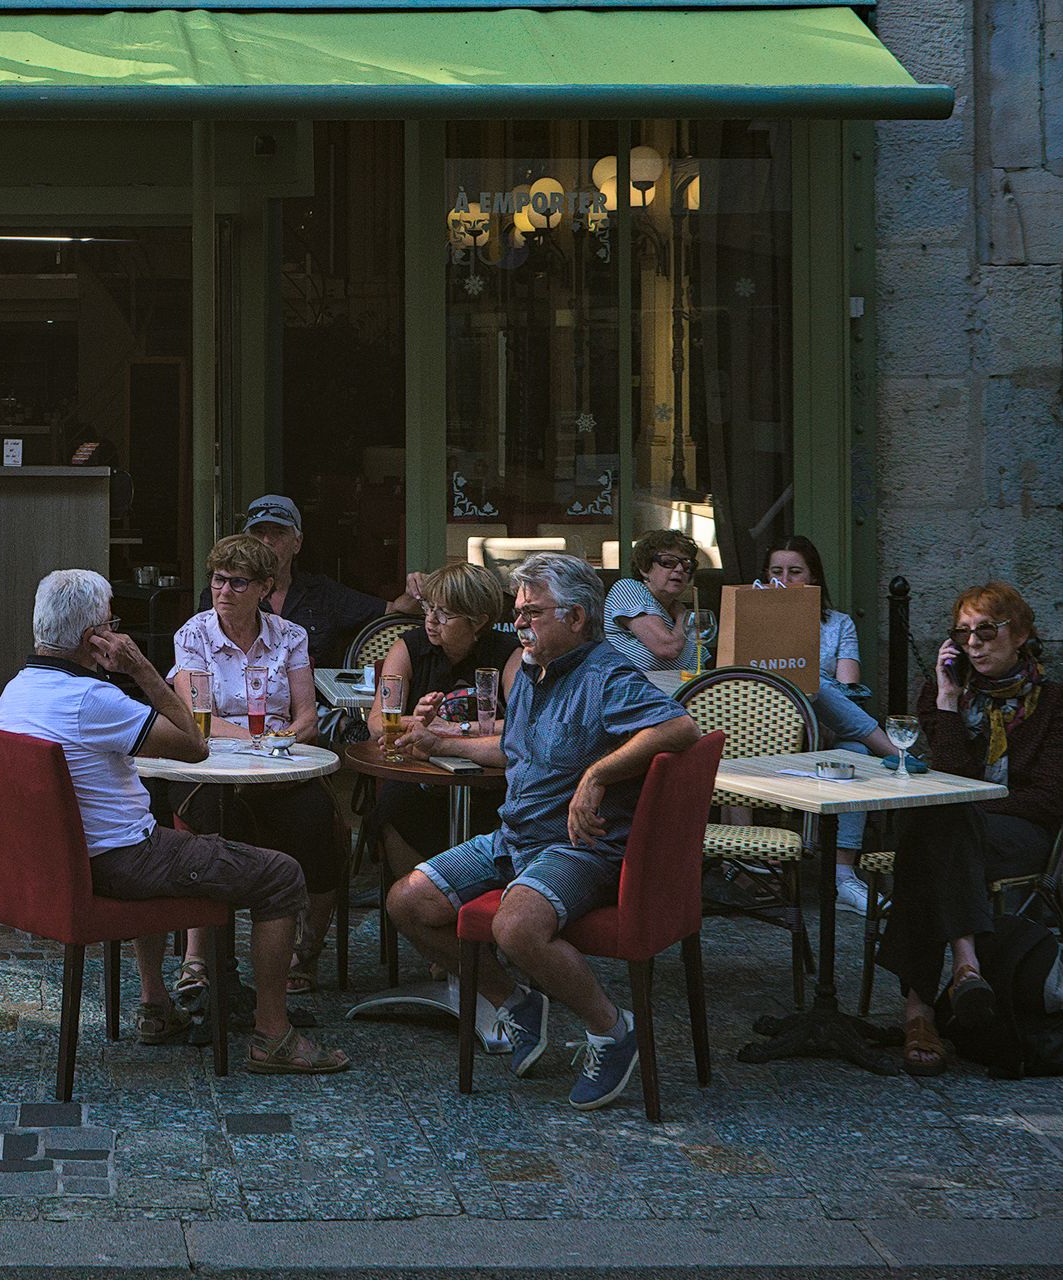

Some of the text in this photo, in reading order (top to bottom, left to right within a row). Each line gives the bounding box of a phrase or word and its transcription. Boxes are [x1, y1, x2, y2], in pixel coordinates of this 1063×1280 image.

[455, 186, 608, 214] À EMPORTER
[749, 657, 807, 670] SANDRO
